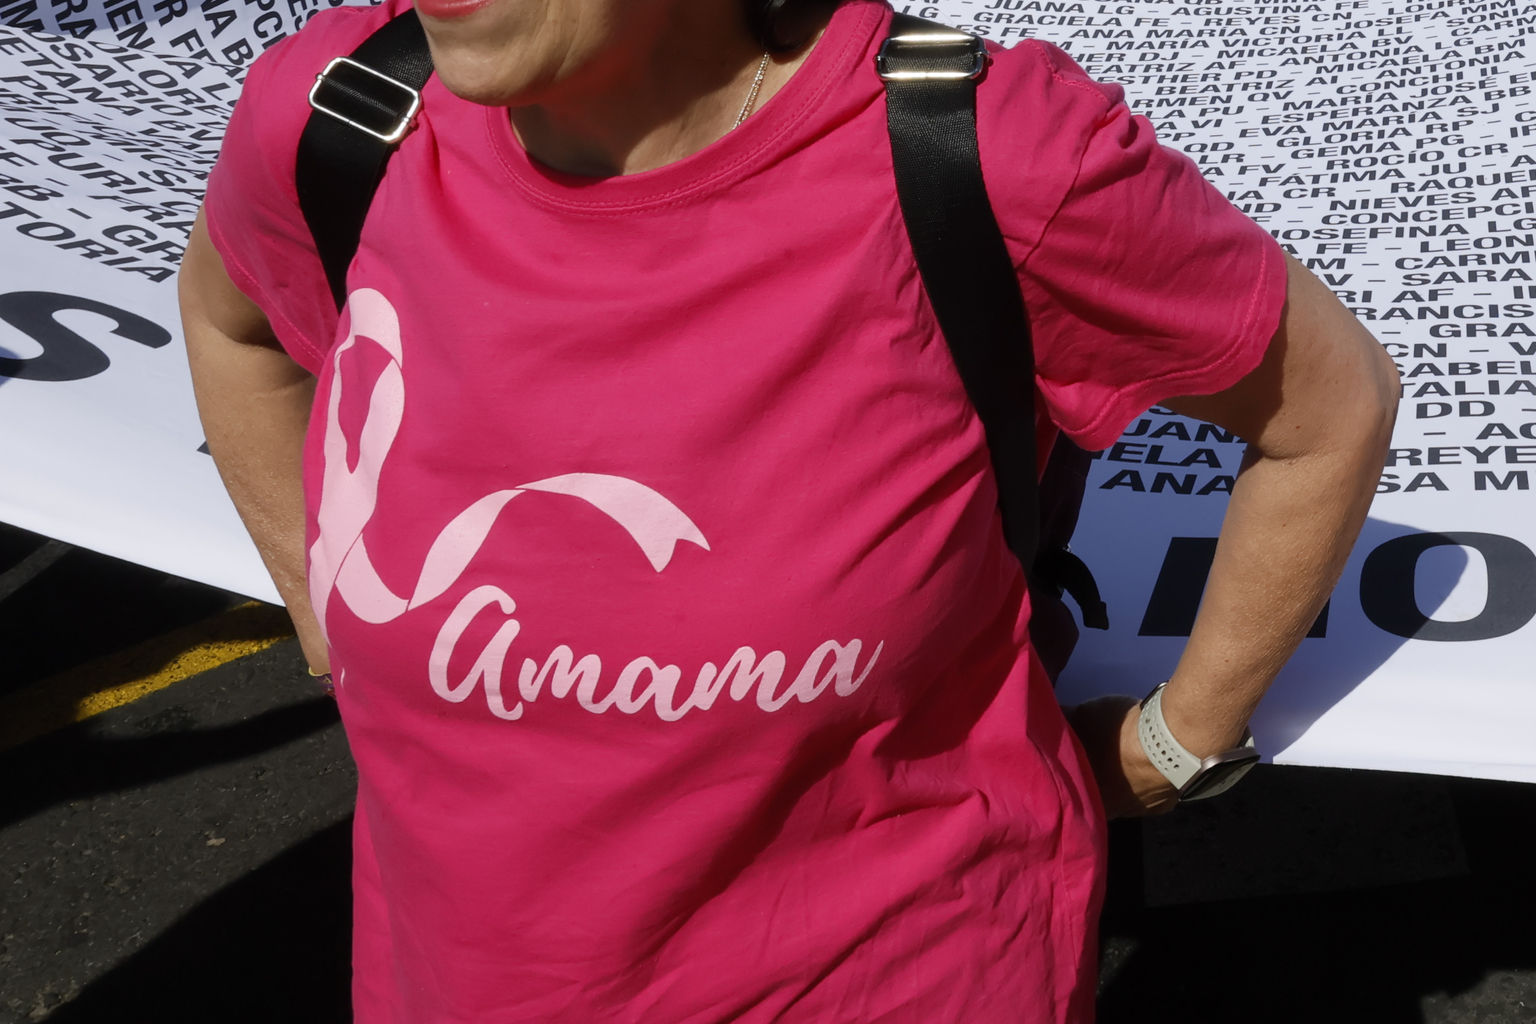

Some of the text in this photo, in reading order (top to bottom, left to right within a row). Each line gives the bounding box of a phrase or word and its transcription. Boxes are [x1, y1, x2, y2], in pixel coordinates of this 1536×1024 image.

[1171, 4, 1323, 16] AGUSTINA
[1276, 127, 1415, 148] GLORIA
[1290, 141, 1402, 159] GEMA
[1415, 134, 1466, 149] PG
[1326, 150, 1445, 171] ROCÍO
[1457, 142, 1510, 158] CR
[1257, 168, 1407, 187] FÁTIMA
[1328, 191, 1478, 211] NIEVES
[1401, 267, 1534, 287] SARA
[1415, 400, 1496, 419] DD
